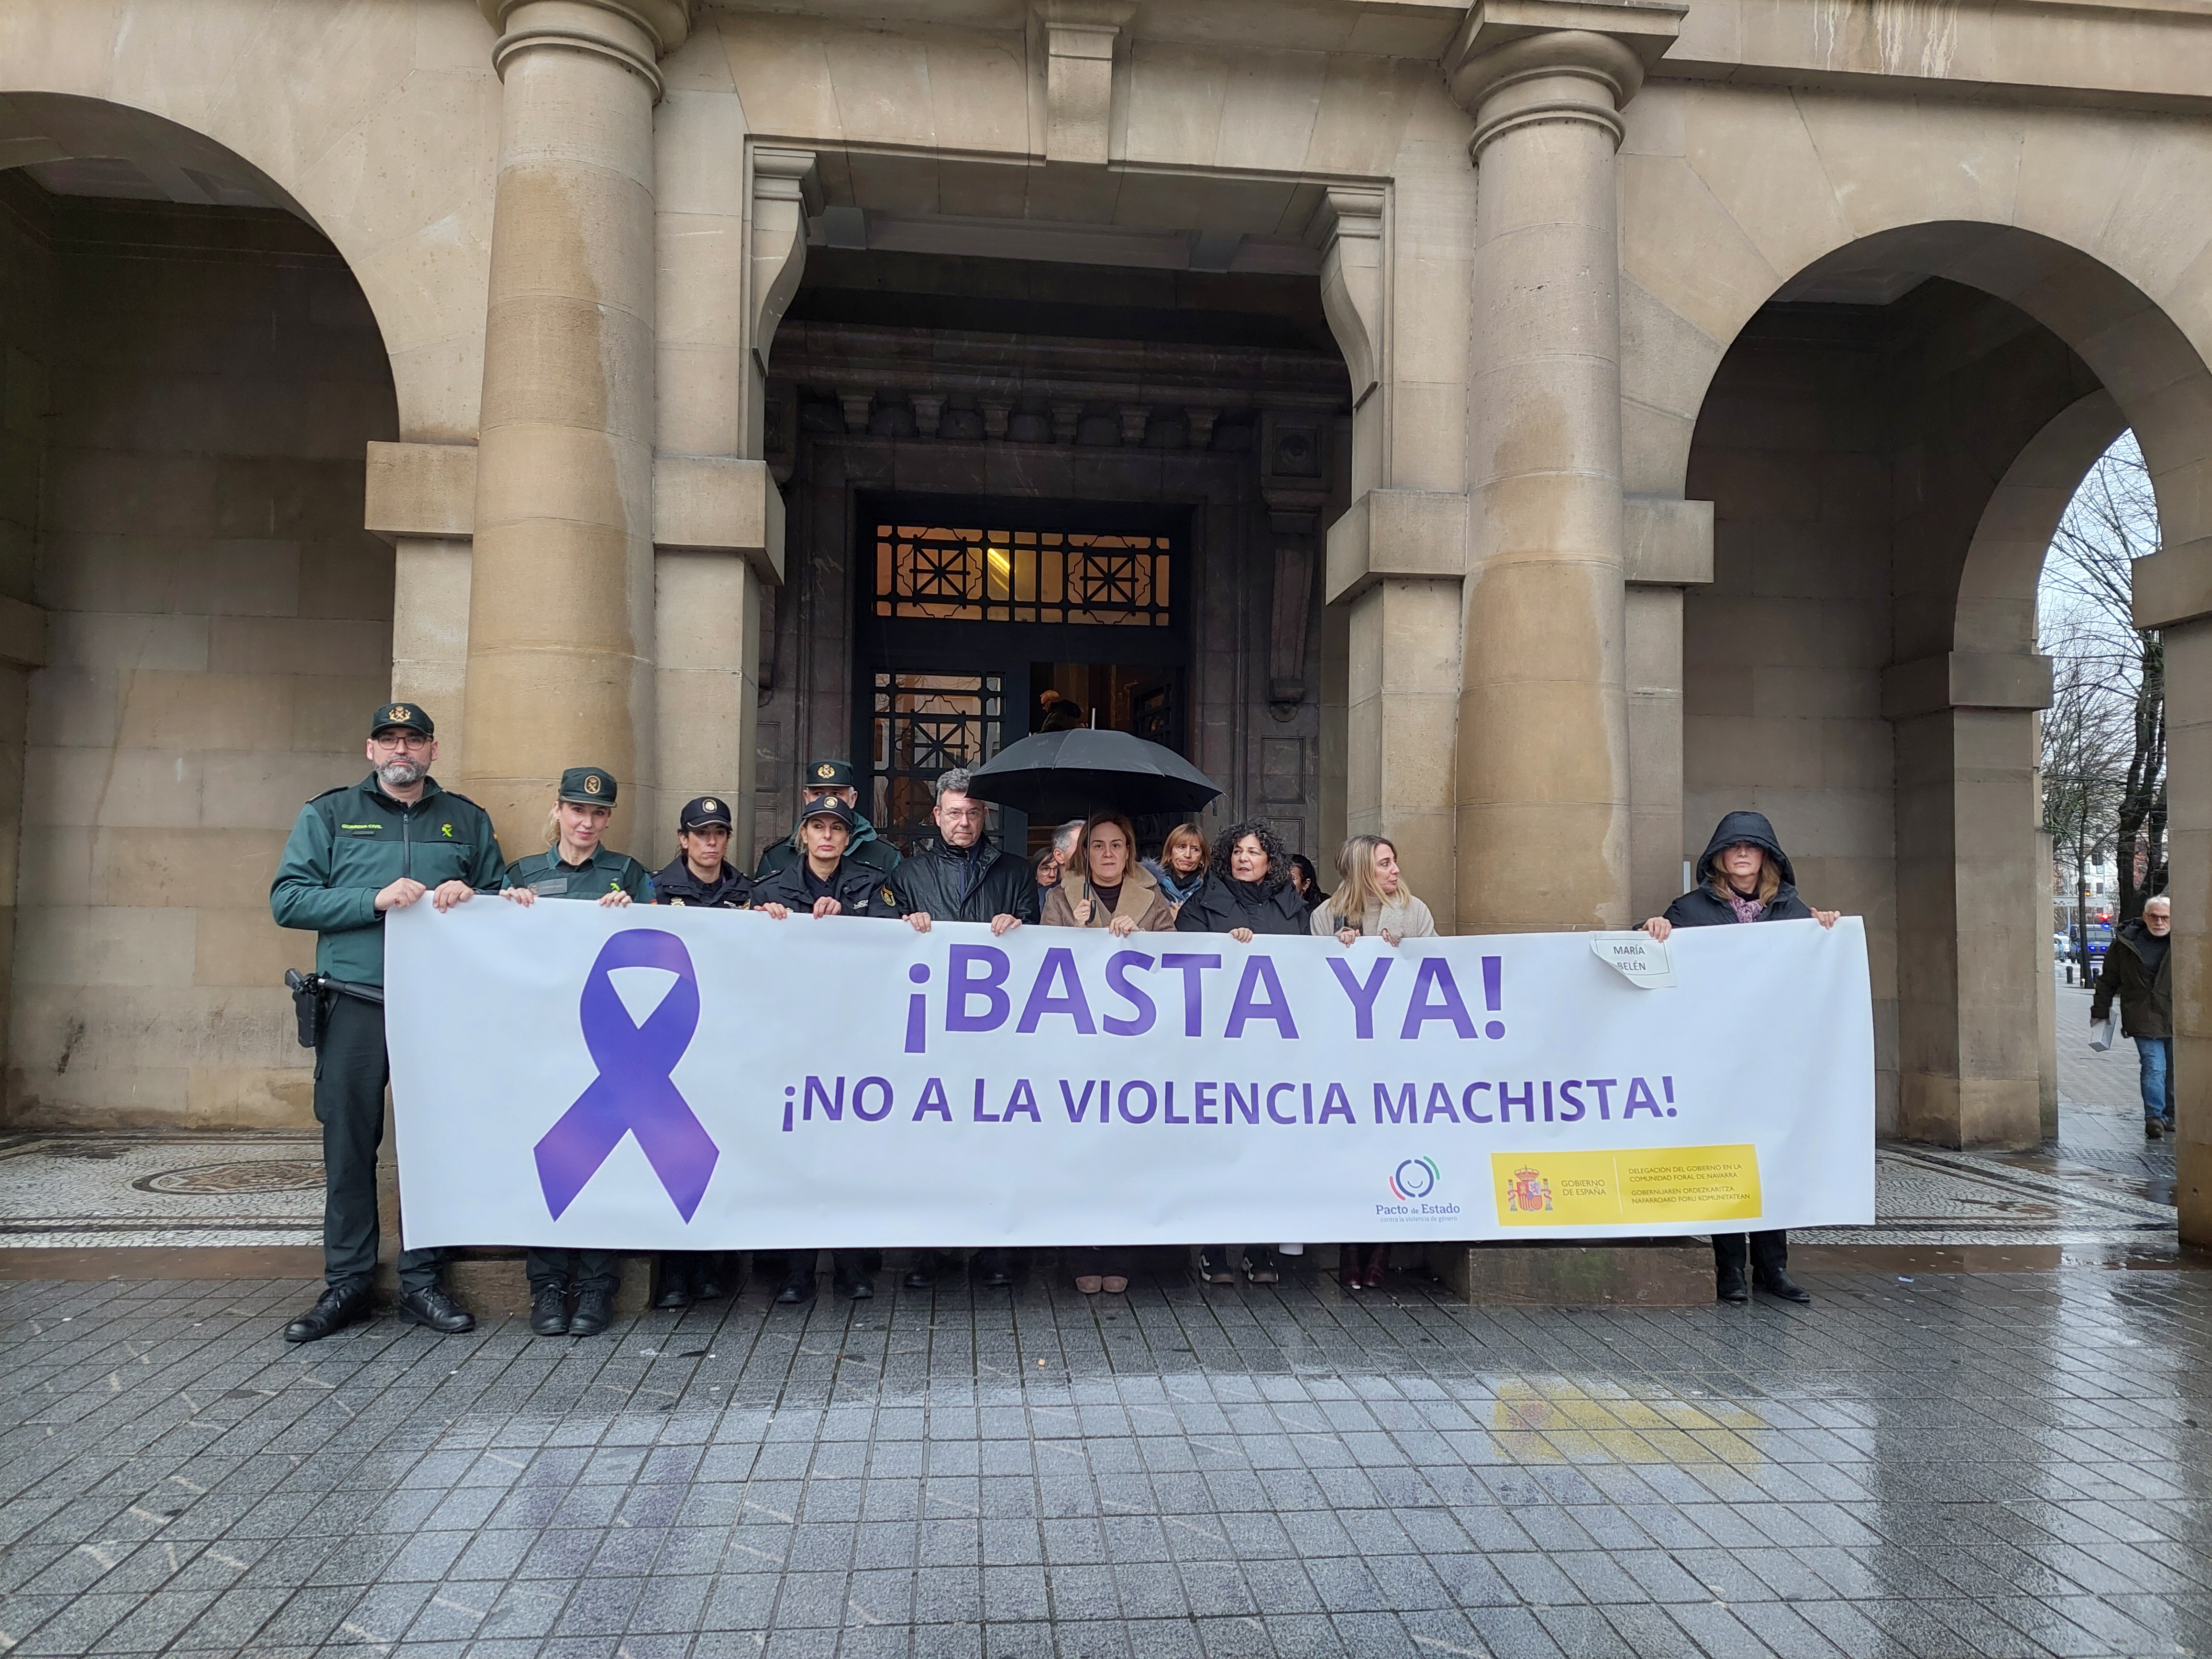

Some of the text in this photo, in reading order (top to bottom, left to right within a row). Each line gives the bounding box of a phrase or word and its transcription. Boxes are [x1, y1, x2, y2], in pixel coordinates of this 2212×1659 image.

[1614, 944, 1646, 955] MARÍA
[1617, 960, 1646, 971] BELÉN
[905, 944, 1505, 1053] ¡BASTA YA!
[783, 1076, 1677, 1131] ¡NO A LA VIOLENCIA MACHISTA!
[1576, 1187, 1606, 1195] ESPAÑA
[1375, 1205, 1408, 1215] Pacto
[1421, 1203, 1460, 1214] Estado
